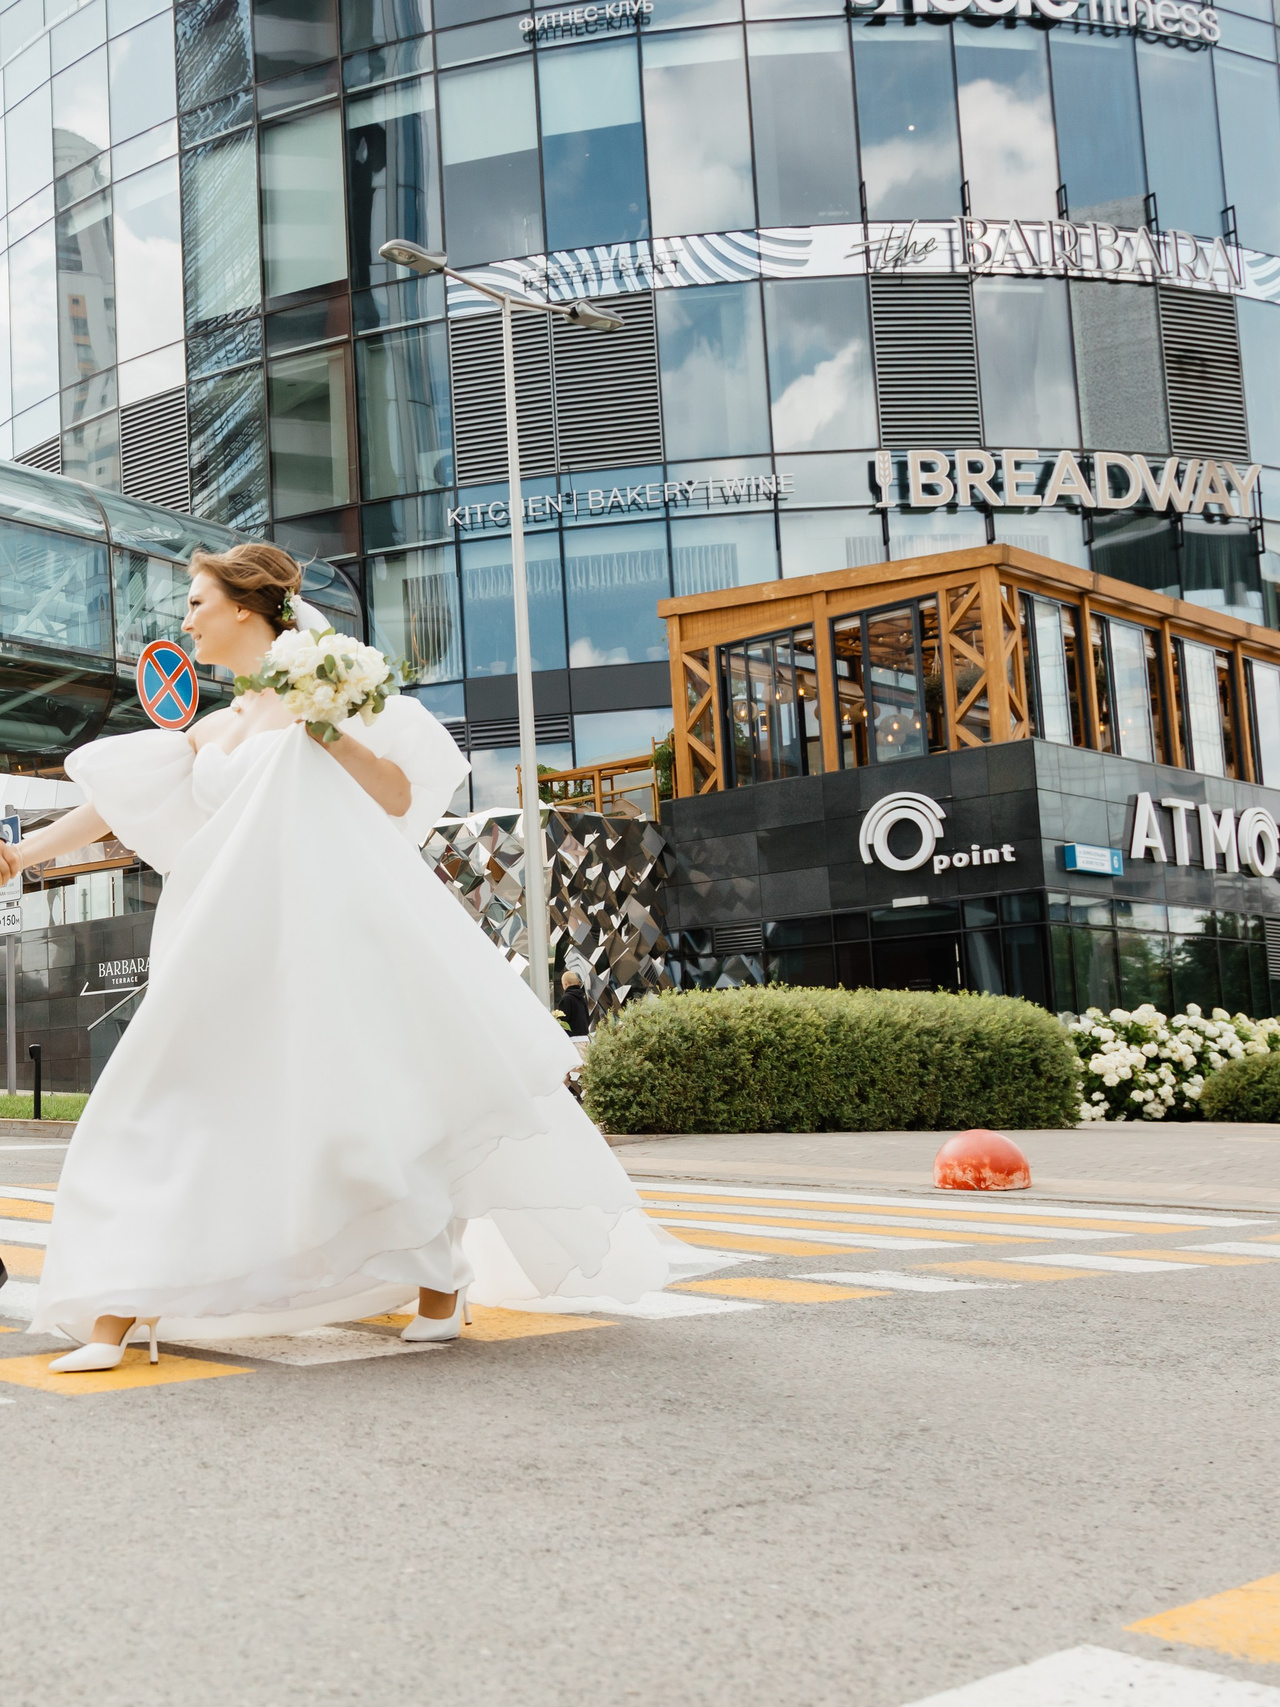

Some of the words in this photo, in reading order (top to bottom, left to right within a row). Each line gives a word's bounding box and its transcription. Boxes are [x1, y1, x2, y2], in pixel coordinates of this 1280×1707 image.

[519, 0, 654, 31] ФИТНЕС-КЛУБ
[850, 219, 938, 266] the
[954, 216, 1244, 288] BARBARA
[588, 480, 699, 509] BAKERY
[722, 473, 795, 497] WINE
[907, 449, 1262, 517] BREADWAY
[933, 844, 1016, 874] point
[1113, 856, 1119, 868] 6
[112, 976, 138, 985] TERRACE
